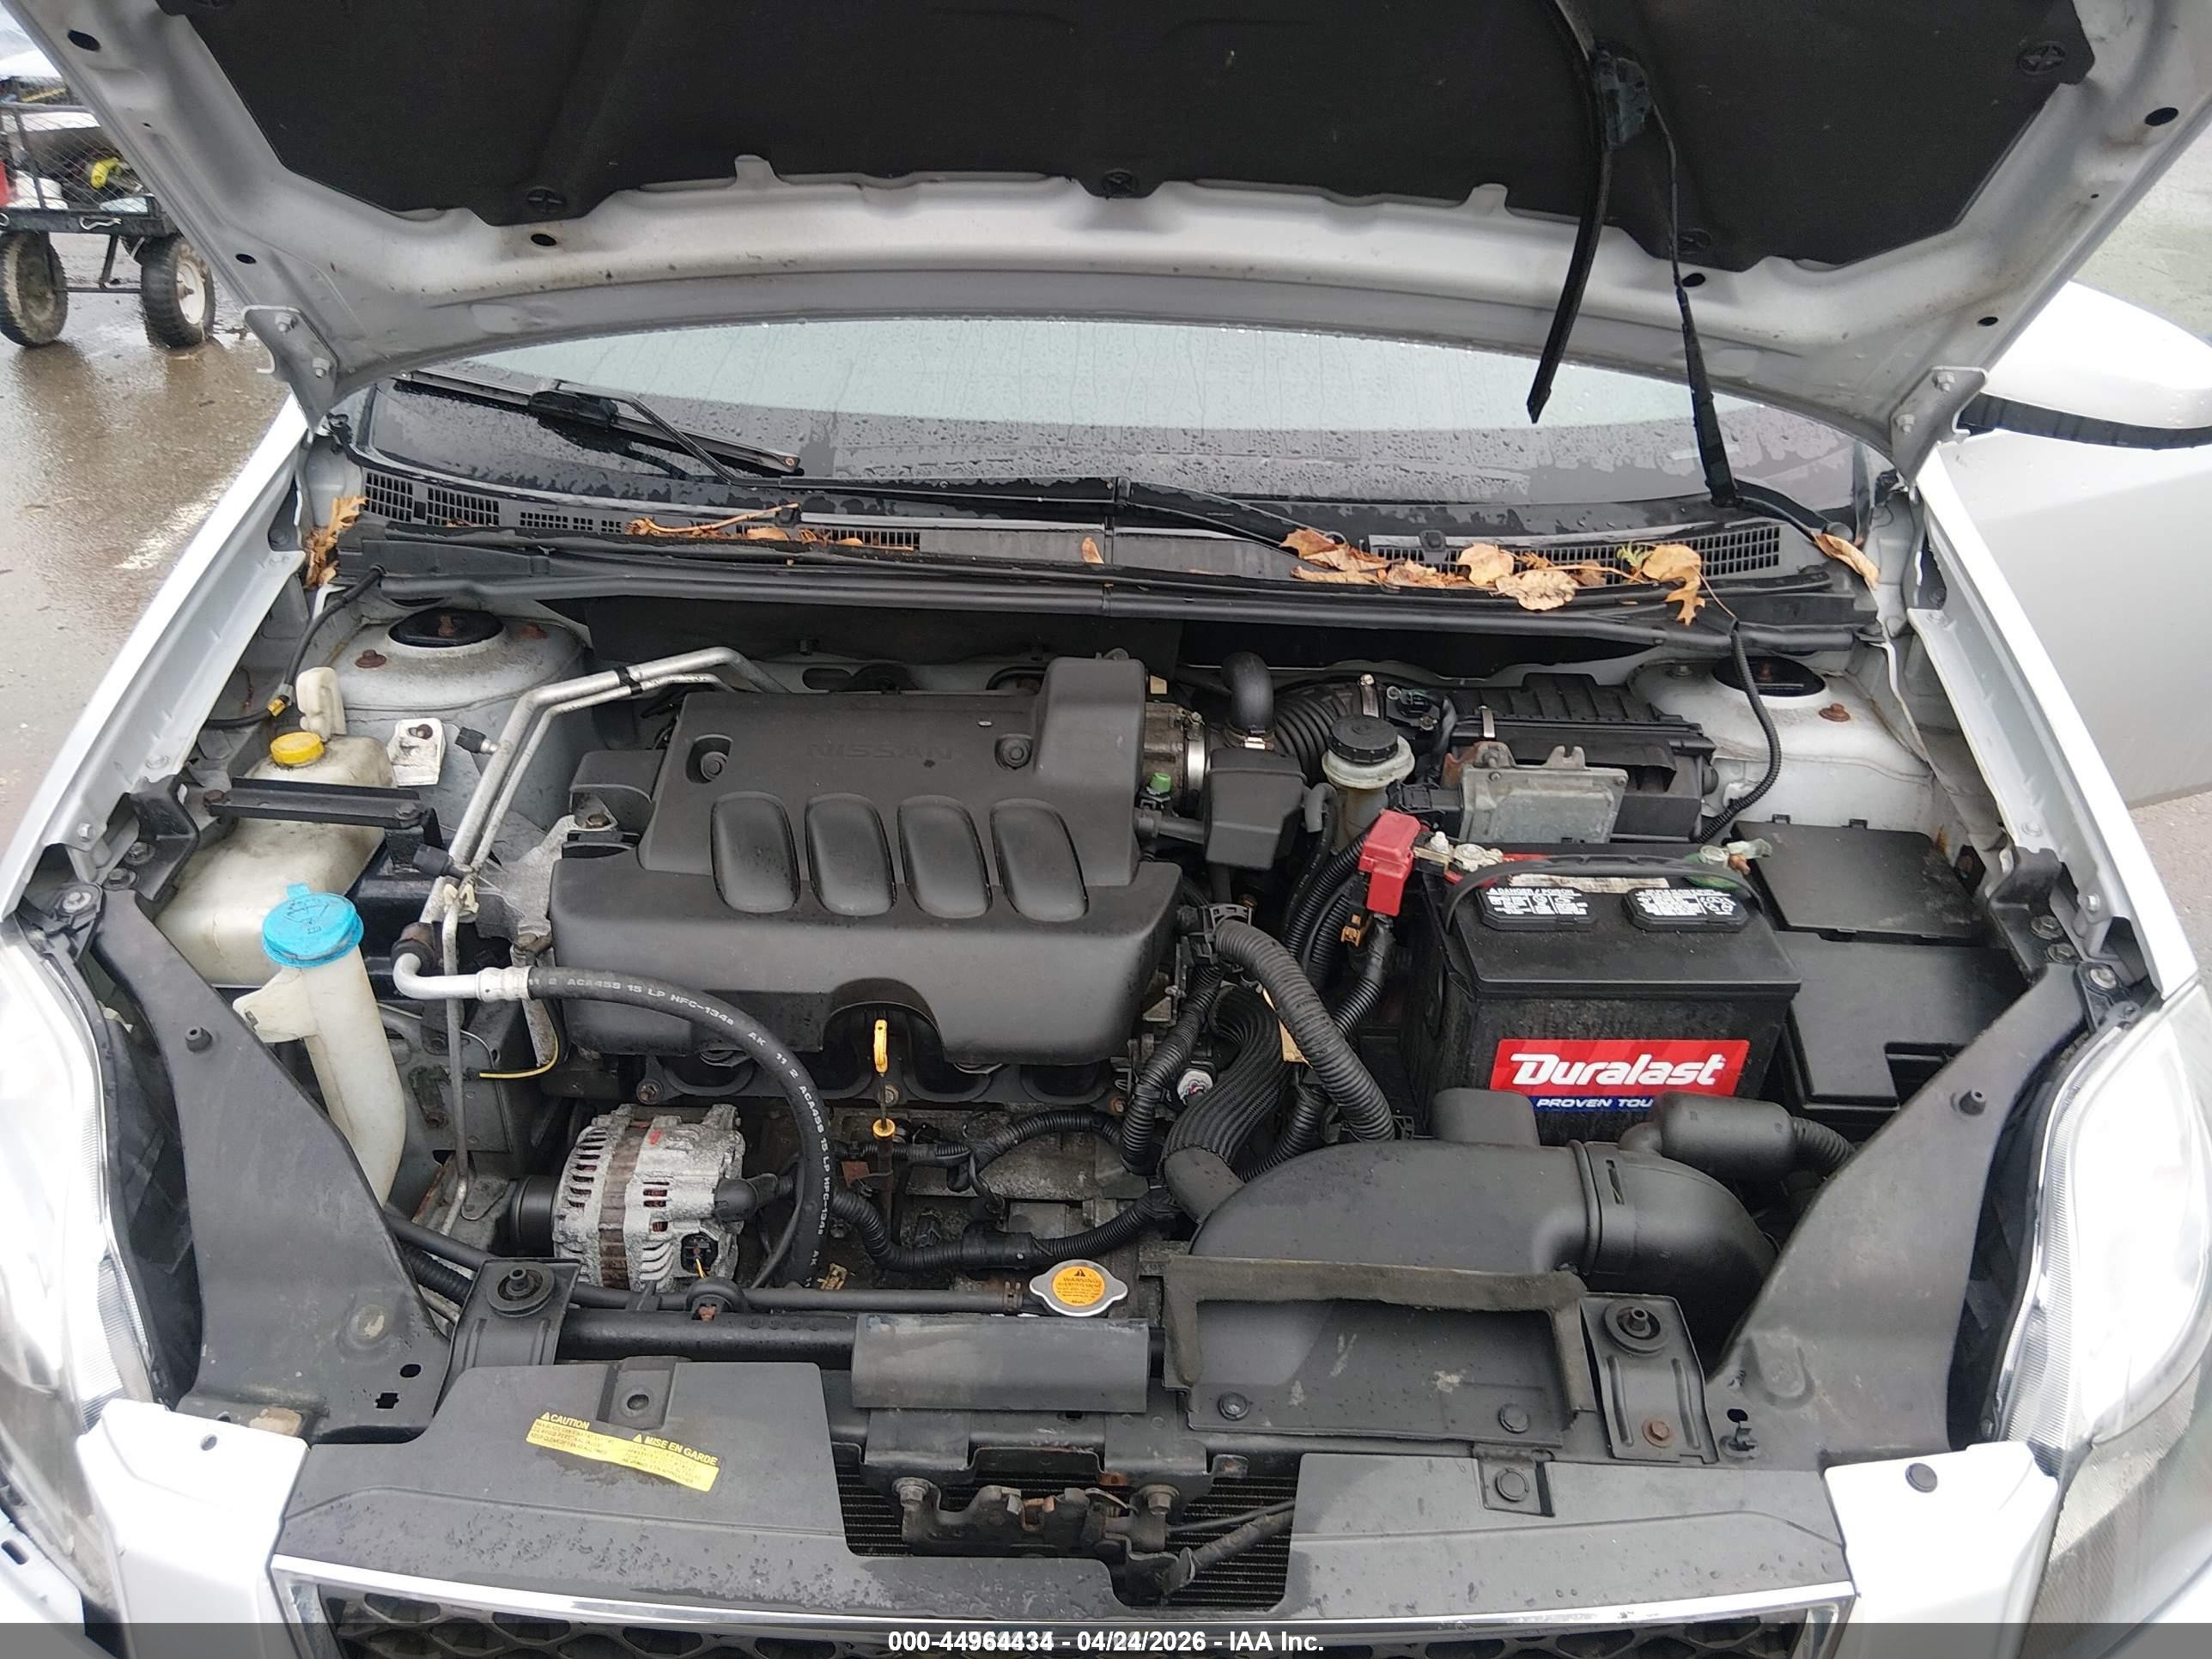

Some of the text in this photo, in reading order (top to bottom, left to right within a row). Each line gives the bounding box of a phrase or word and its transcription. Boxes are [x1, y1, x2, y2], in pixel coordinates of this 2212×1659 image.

[627, 983, 642, 994] 15
[647, 988, 666, 999] LP
[748, 1031, 766, 1046] AK
[775, 1052, 787, 1066] 11
[789, 1068, 799, 1079] 2
[1510, 1053, 1727, 1086] Duralast
[1536, 1097, 1653, 1109] PROVEN TOU
[820, 1137, 829, 1152] 15
[822, 1156, 831, 1173] LP
[550, 1413, 590, 1431] CAUTION
[644, 1435, 720, 1467] MISE EN GARDE
